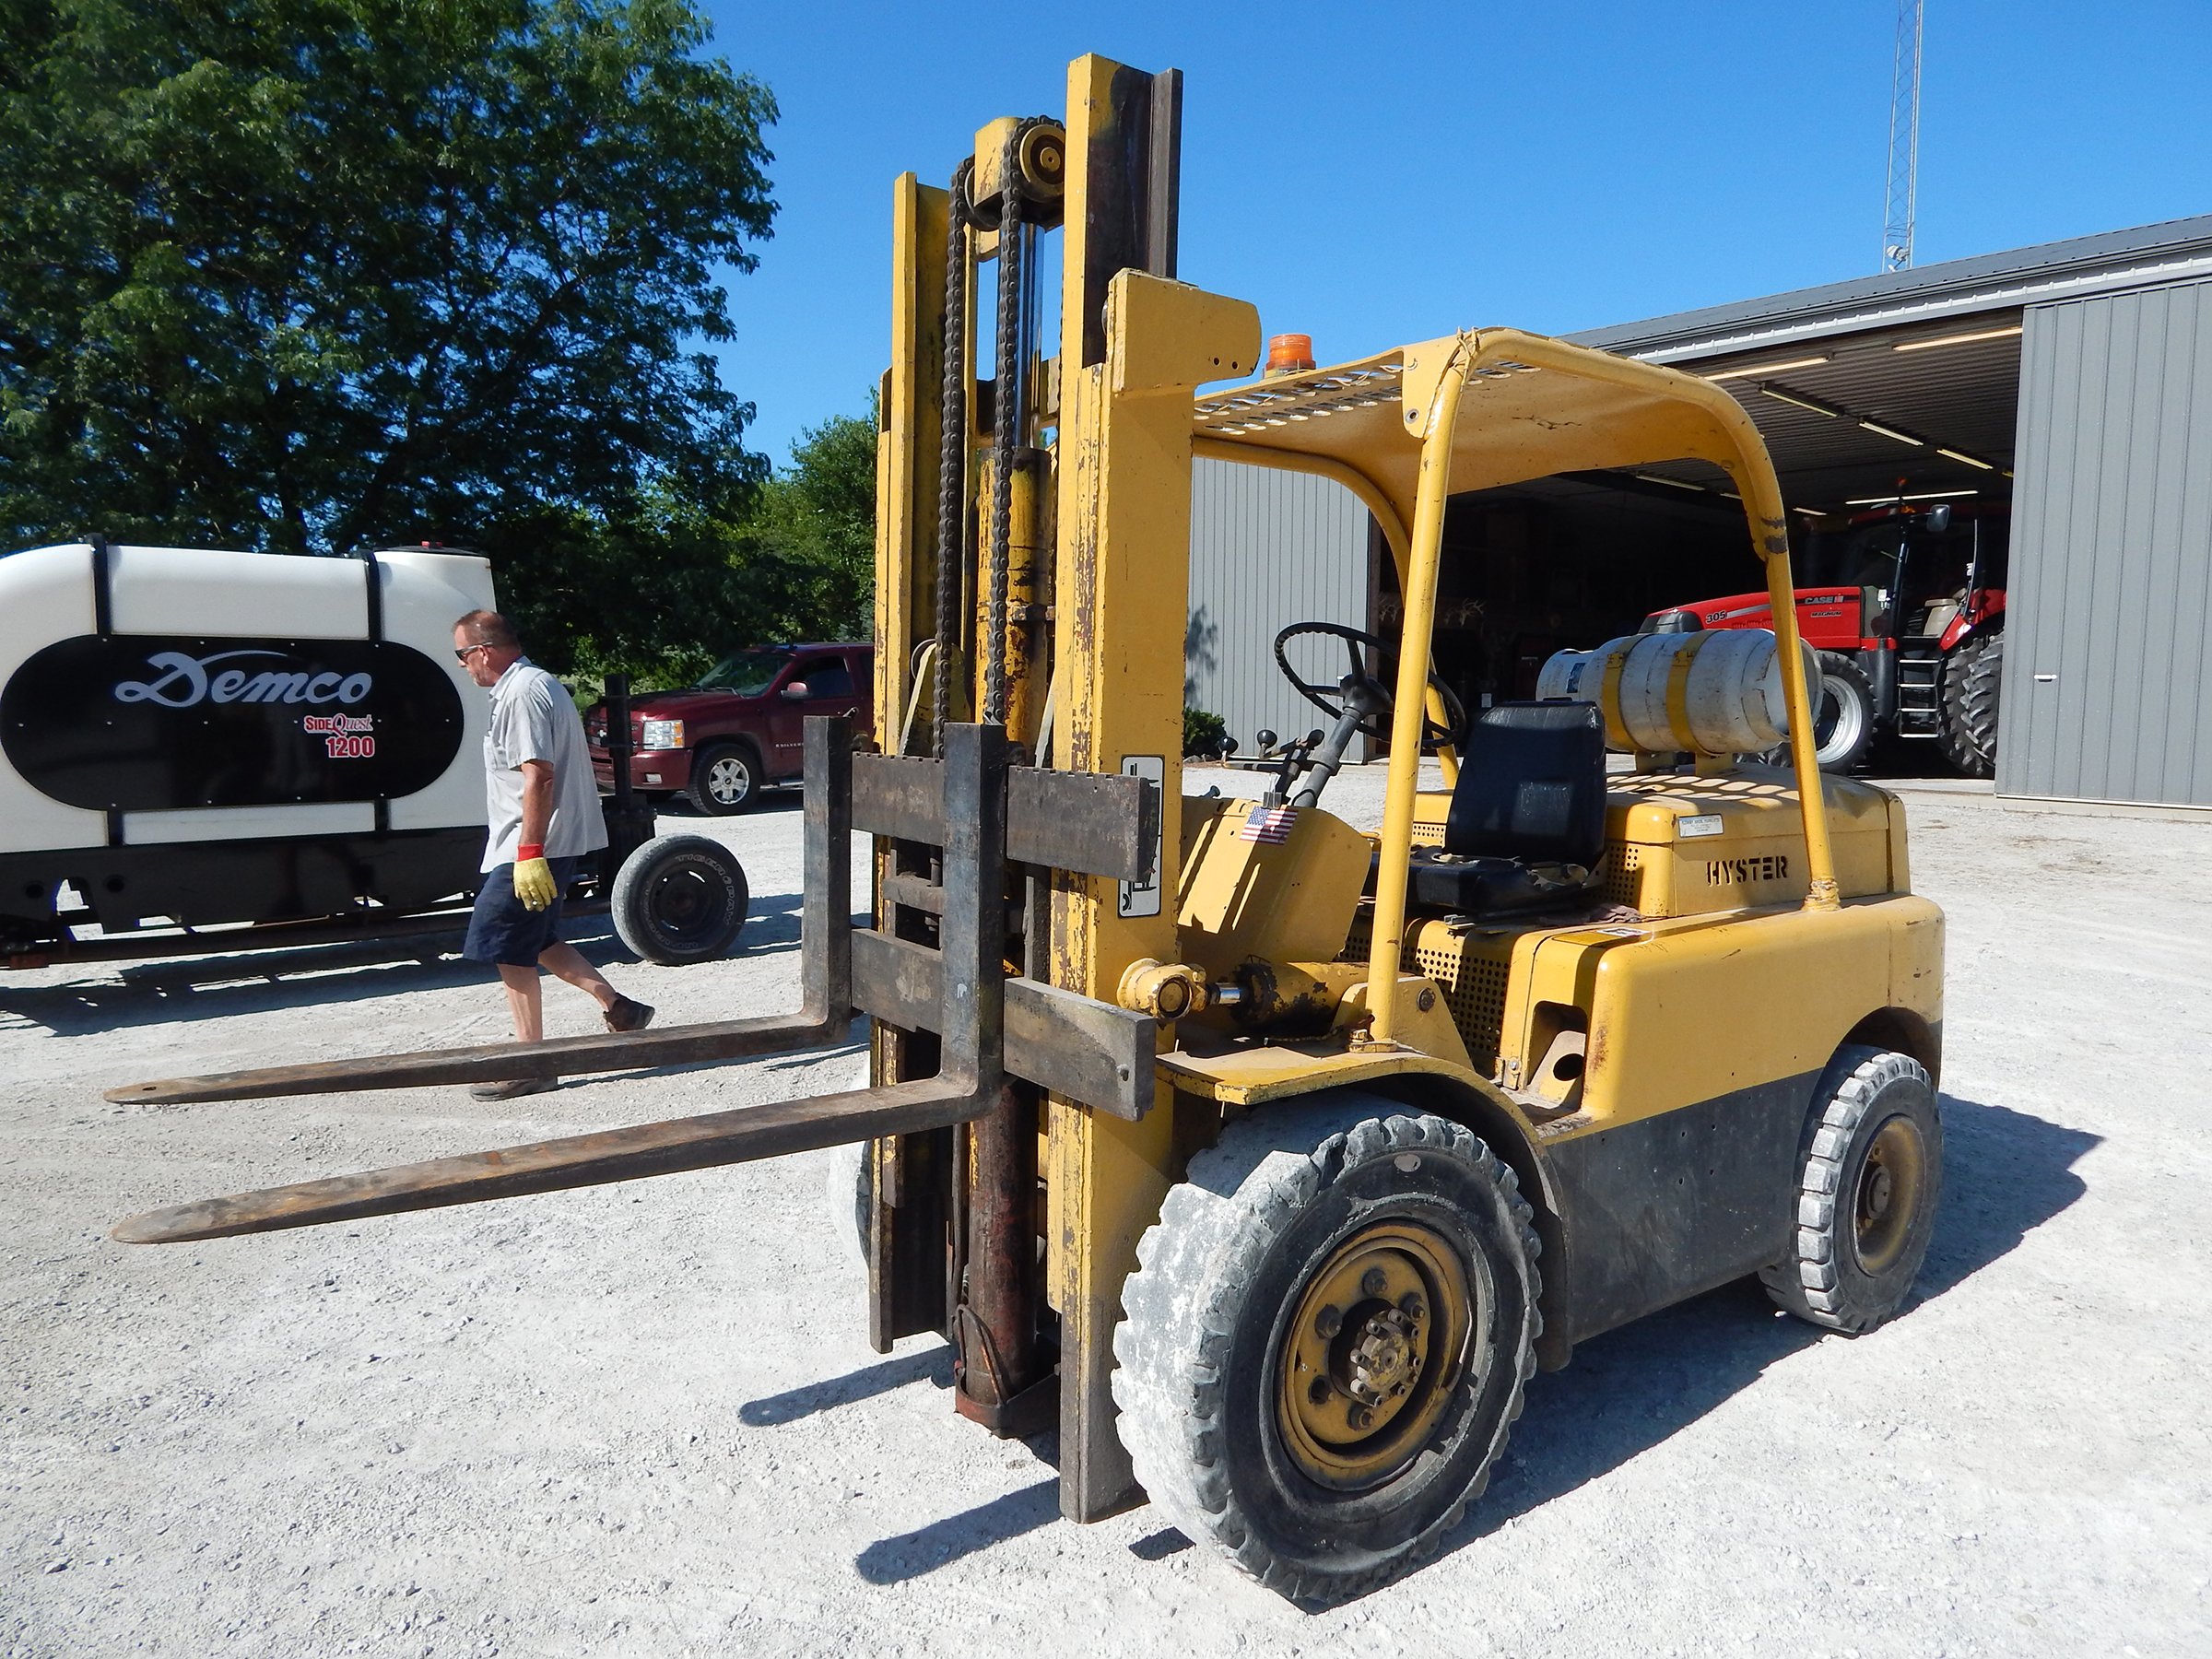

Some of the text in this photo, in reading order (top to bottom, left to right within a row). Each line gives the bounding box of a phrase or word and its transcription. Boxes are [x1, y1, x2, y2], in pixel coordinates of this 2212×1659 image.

[1805, 596, 1833, 605] CASE
[1706, 611, 1726, 624] 305
[1810, 610, 1842, 618] MAGNUM
[114, 650, 372, 708] Demco
[325, 735, 375, 758] 1200
[1707, 855, 1788, 886] HYSTER
